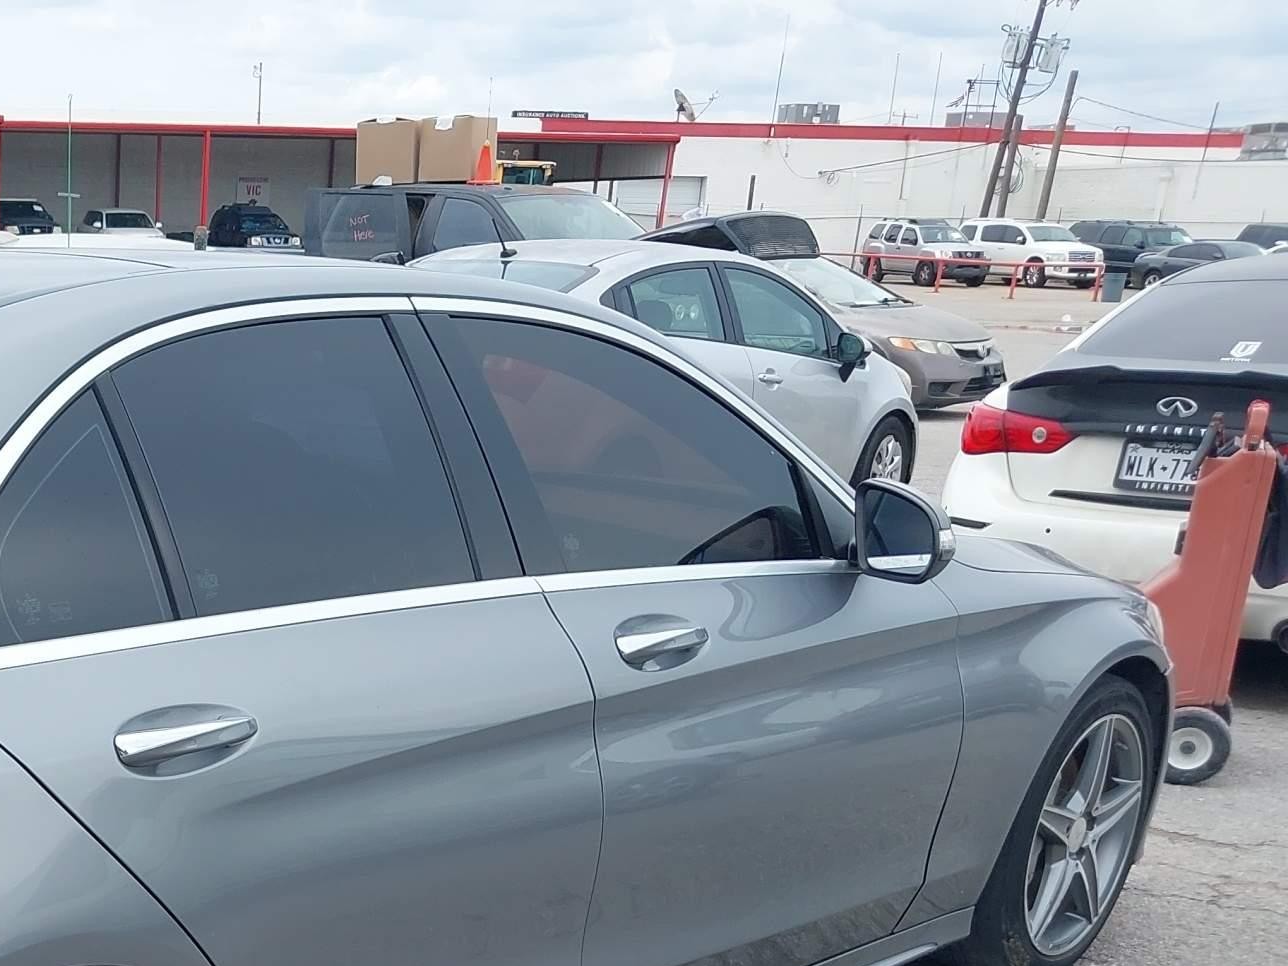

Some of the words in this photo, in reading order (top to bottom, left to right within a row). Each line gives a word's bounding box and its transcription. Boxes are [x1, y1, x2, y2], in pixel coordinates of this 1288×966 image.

[246, 184, 262, 196] VIC
[349, 214, 370, 227] NOT
[1125, 424, 1208, 437] INFINIT
[1135, 481, 1190, 492] INFINITI
